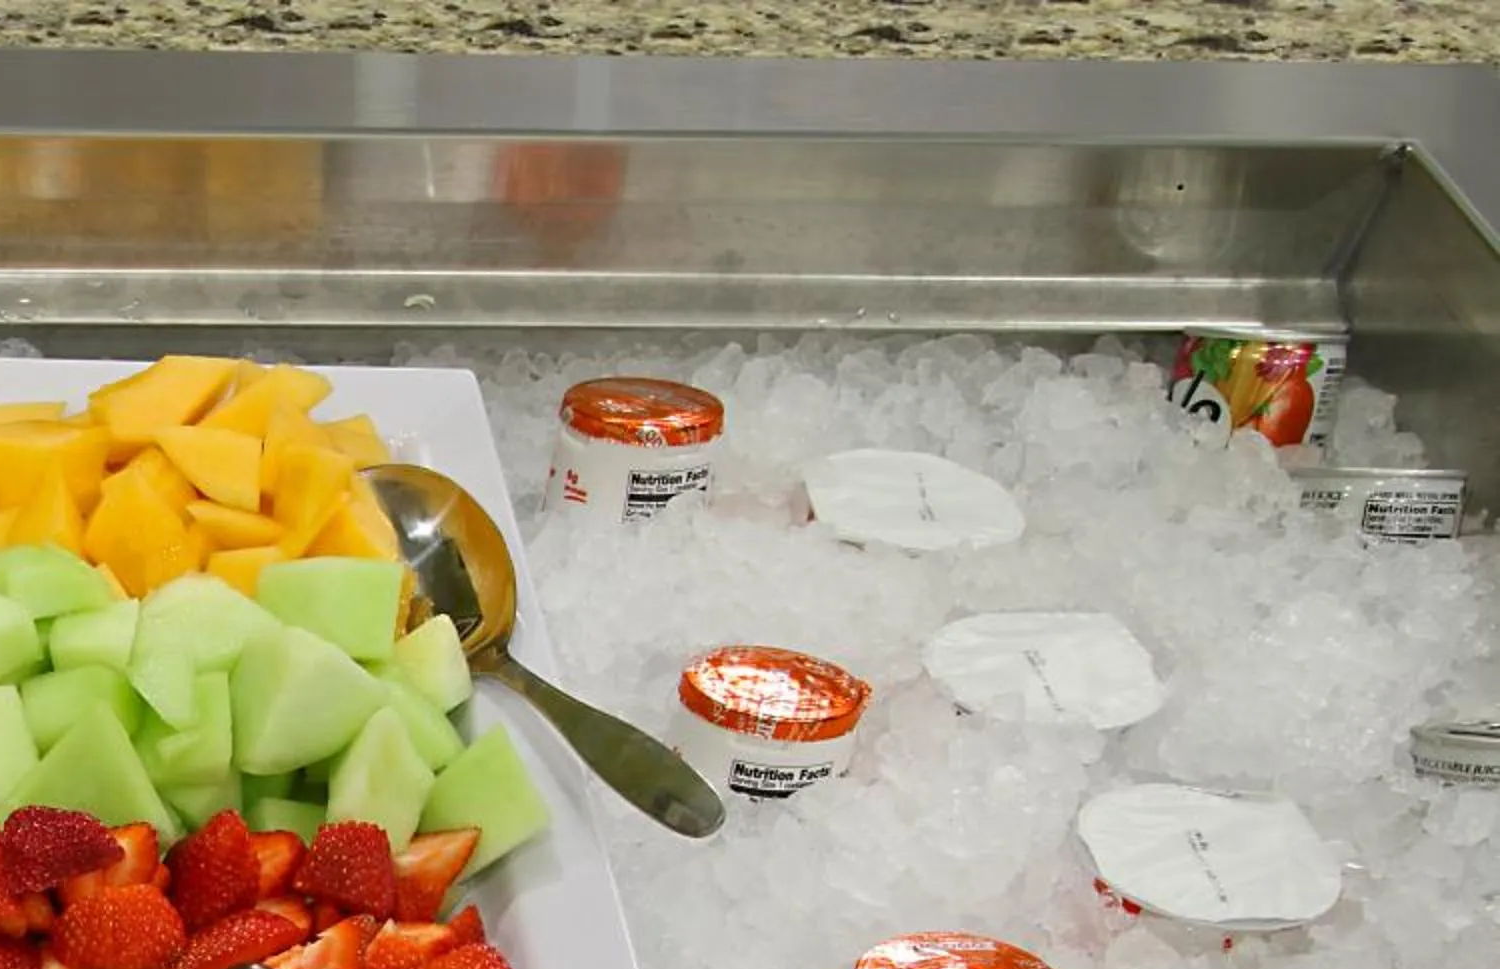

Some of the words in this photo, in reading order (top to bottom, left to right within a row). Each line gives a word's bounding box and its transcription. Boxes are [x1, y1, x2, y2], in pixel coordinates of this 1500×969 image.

[631, 471, 684, 486] Nutrition
[1367, 503, 1428, 515] Nutrition
[734, 762, 795, 781] Nutrition
[799, 767, 832, 782] Facts
